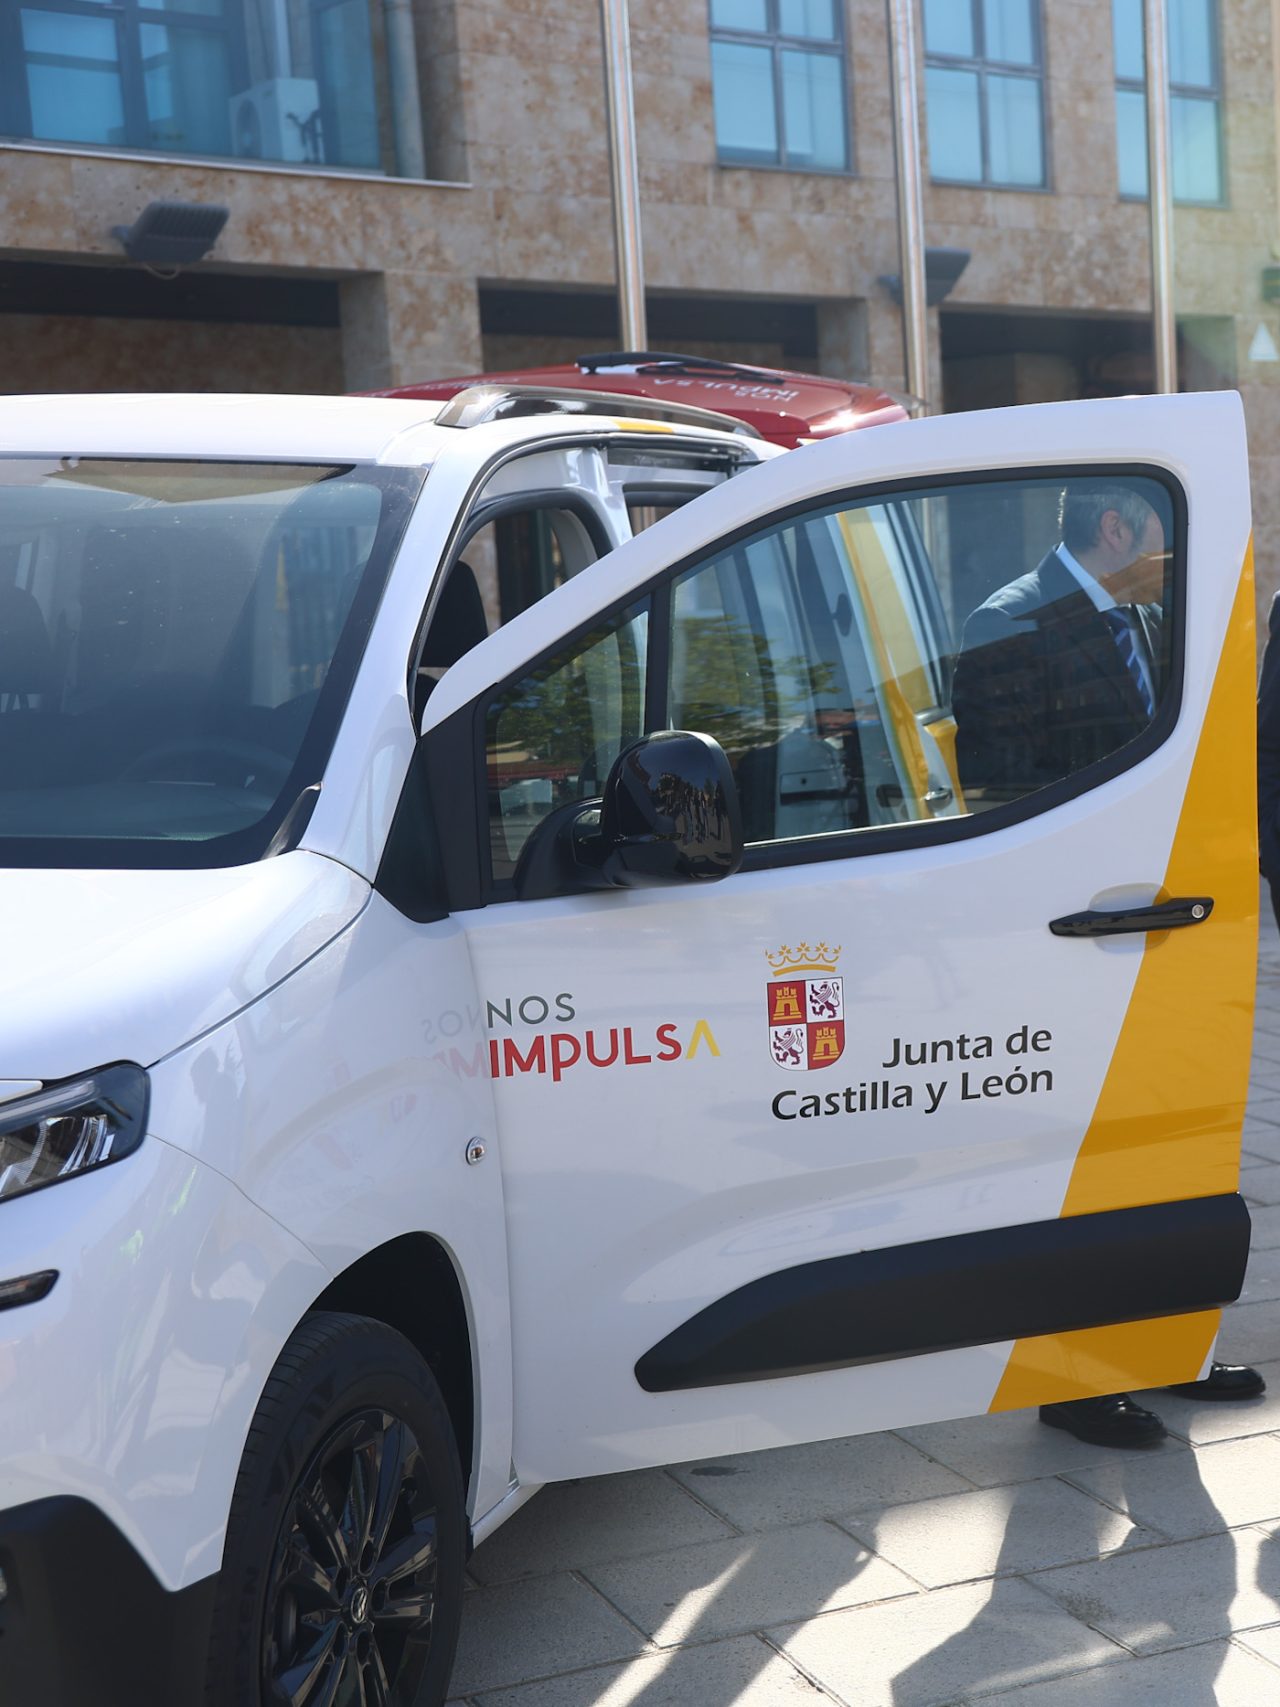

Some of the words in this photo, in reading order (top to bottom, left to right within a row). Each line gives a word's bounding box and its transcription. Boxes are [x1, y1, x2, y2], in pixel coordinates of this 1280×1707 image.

[486, 993, 576, 1029] NOS
[882, 1034, 993, 1068] Junta
[1005, 1025, 1053, 1055] de
[771, 1080, 913, 1120] Castilla
[924, 1081, 948, 1114] y
[961, 1066, 1053, 1101] León
